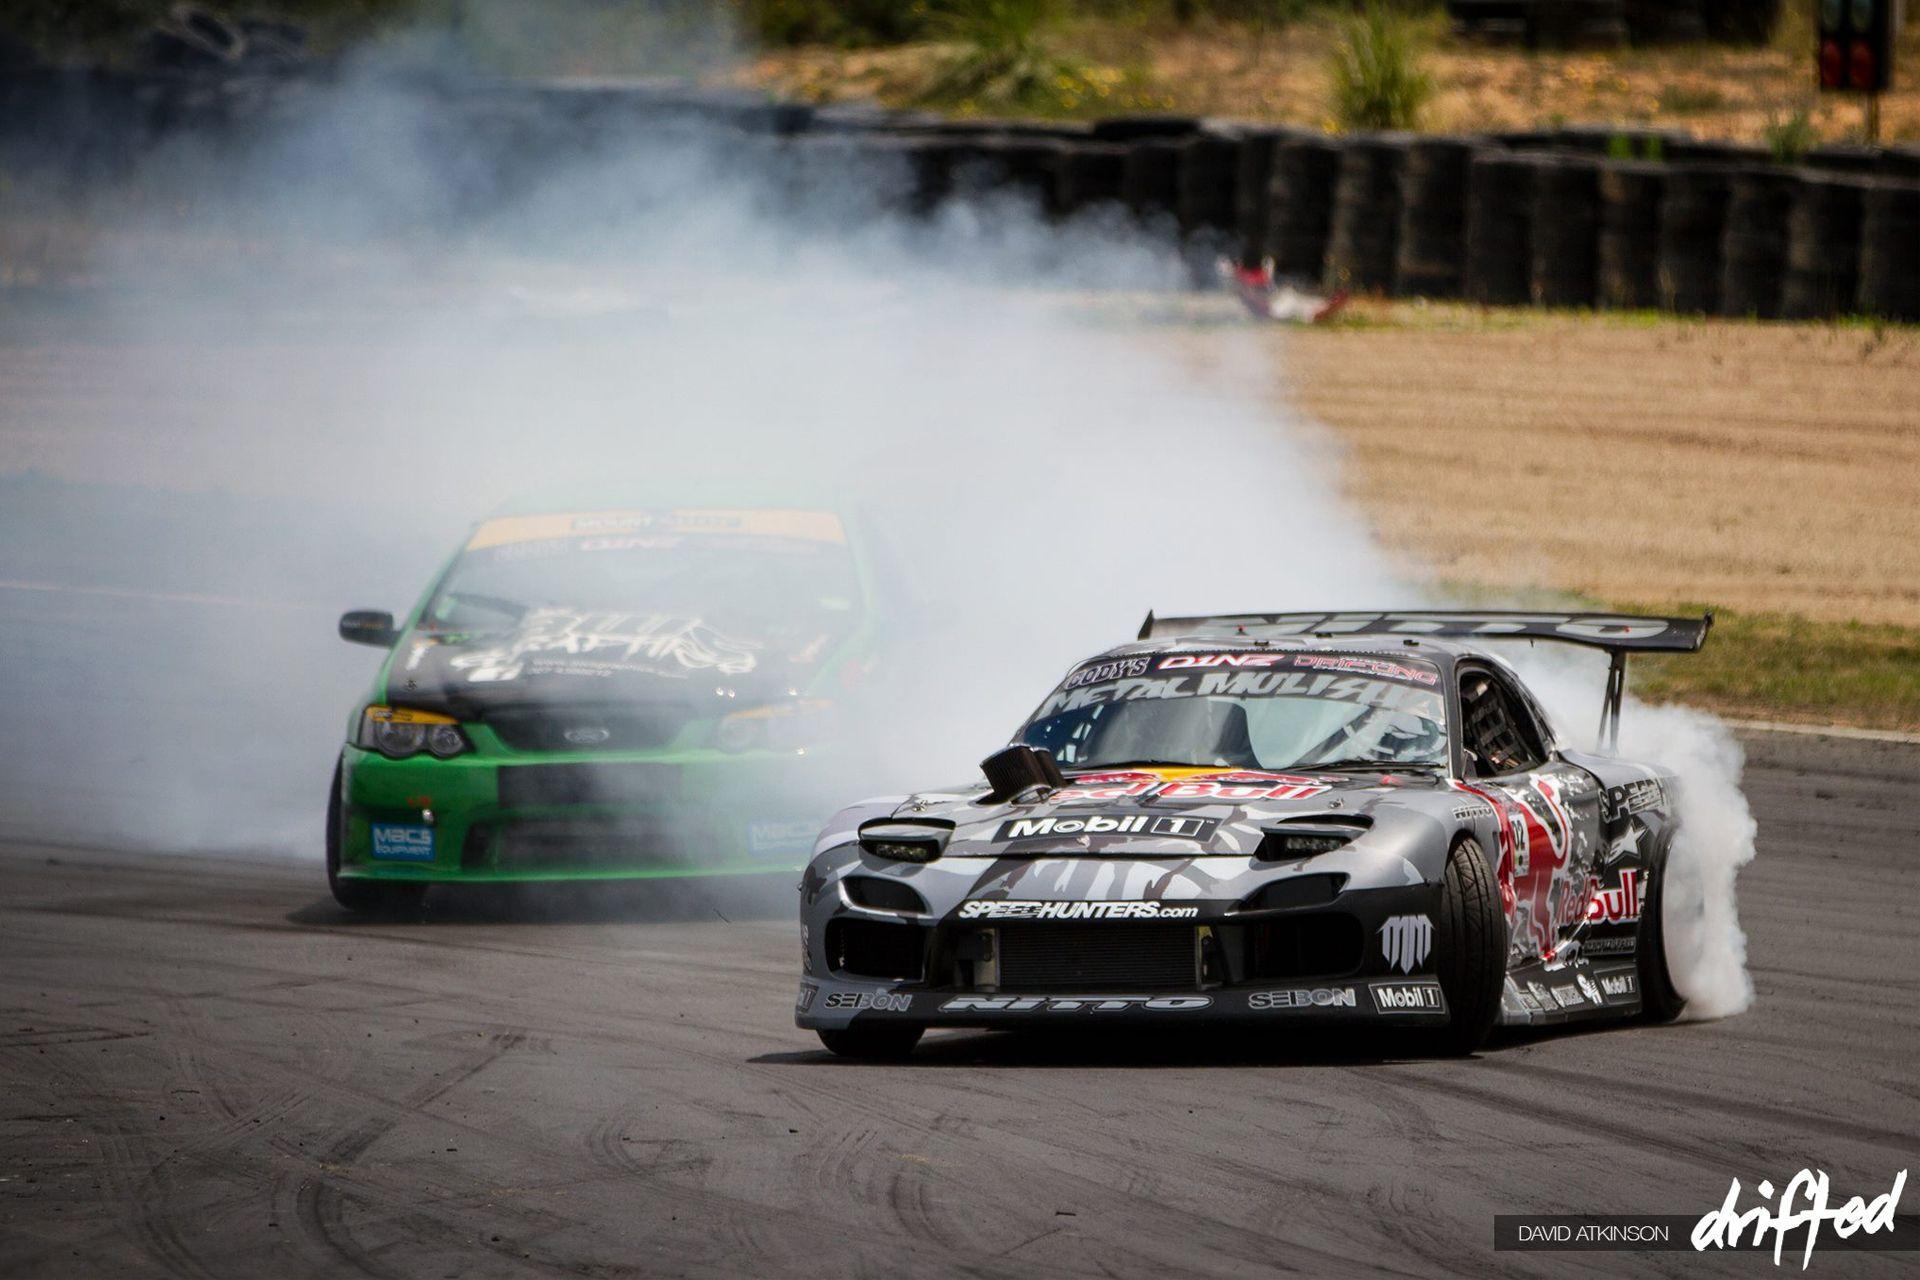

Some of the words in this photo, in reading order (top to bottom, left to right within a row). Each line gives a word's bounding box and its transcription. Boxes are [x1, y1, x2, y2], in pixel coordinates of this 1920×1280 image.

[1066, 656, 1151, 690] CODY'S
[1157, 653, 1286, 670] D1NZ
[1038, 676, 1196, 721] METAL
[1155, 782, 1333, 800] Bull
[1008, 815, 1150, 838] Mobil
[958, 900, 1199, 920] SPEEDHUNTERS.com
[824, 992, 913, 1012] SEIBON
[942, 995, 1214, 1012] NITTO
[1248, 988, 1357, 1010] SEIBON
[1377, 987, 1425, 1008] Mobil
